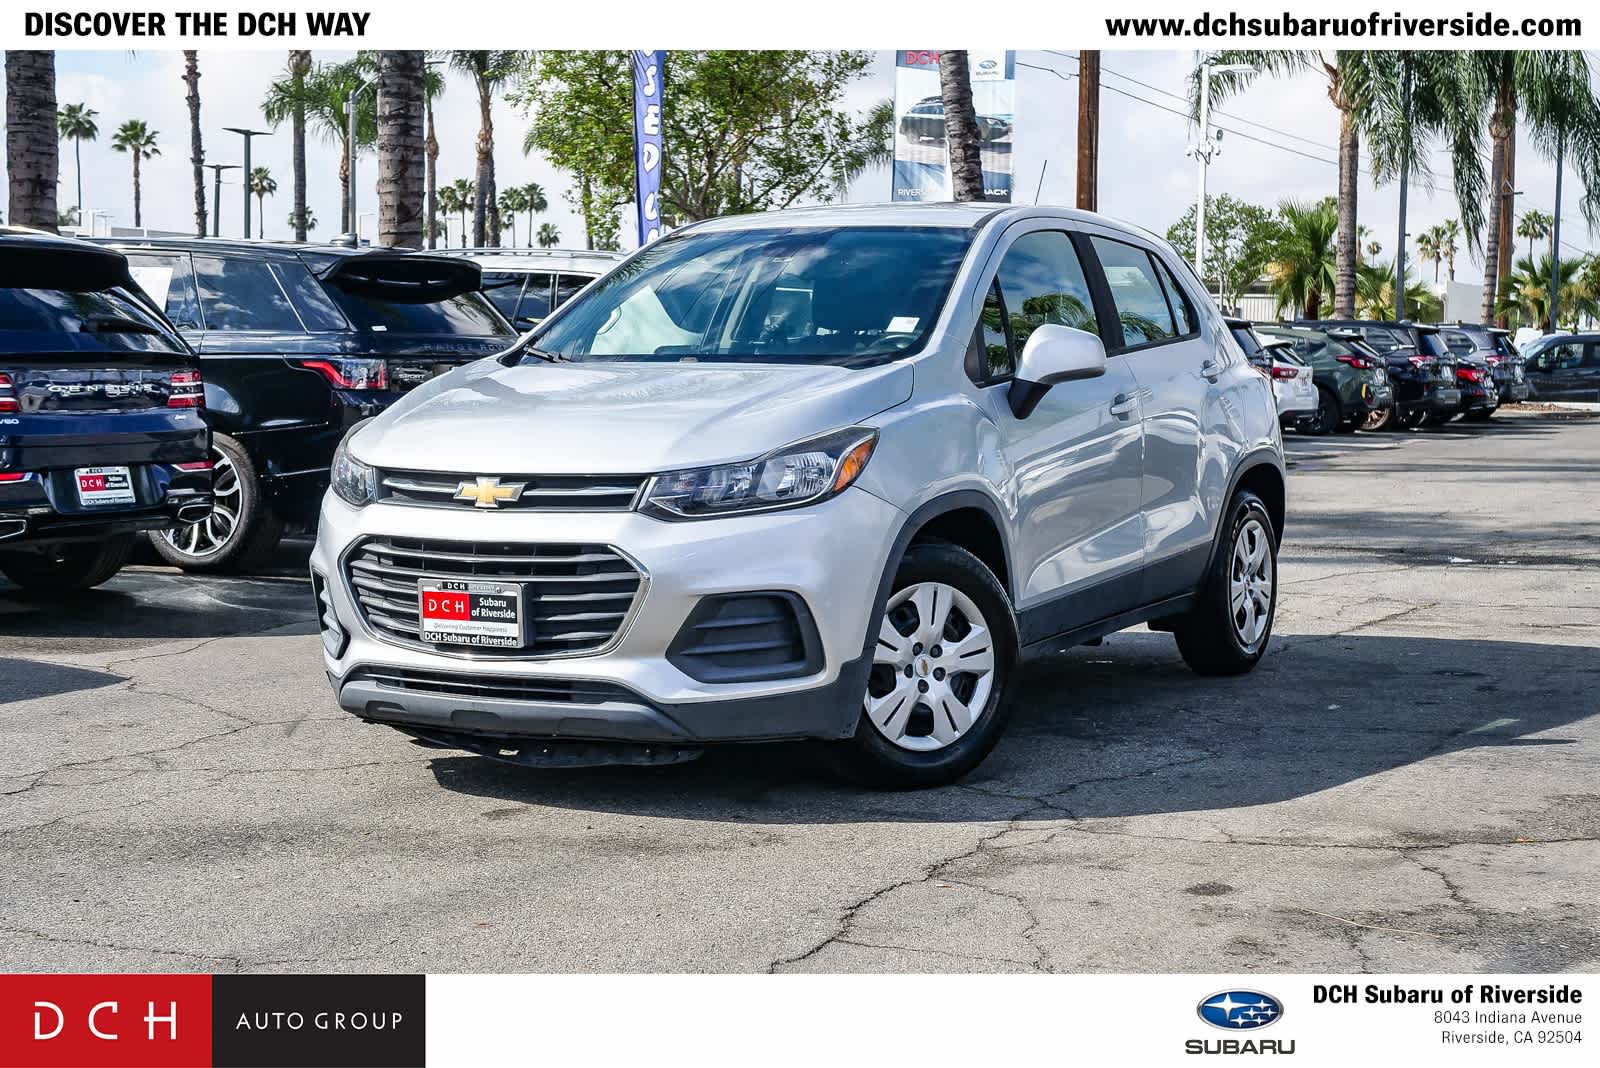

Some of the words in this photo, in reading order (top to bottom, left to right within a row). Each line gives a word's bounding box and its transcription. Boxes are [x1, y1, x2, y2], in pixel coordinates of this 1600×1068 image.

[905, 50, 941, 65] DCH
[643, 50, 660, 174] SED
[984, 188, 1008, 196] ACK
[48, 384, 153, 393] GENESIS
[81, 479, 103, 488] DCH
[447, 582, 465, 590] DCH
[428, 598, 465, 613] DCH
[479, 597, 507, 607] Subaru
[471, 608, 480, 617] of
[481, 608, 516, 619] Riverside
[424, 632, 441, 641] DCH
[442, 633, 470, 643] Subaru
[471, 635, 480, 644] of
[481, 636, 517, 647] Riverside
